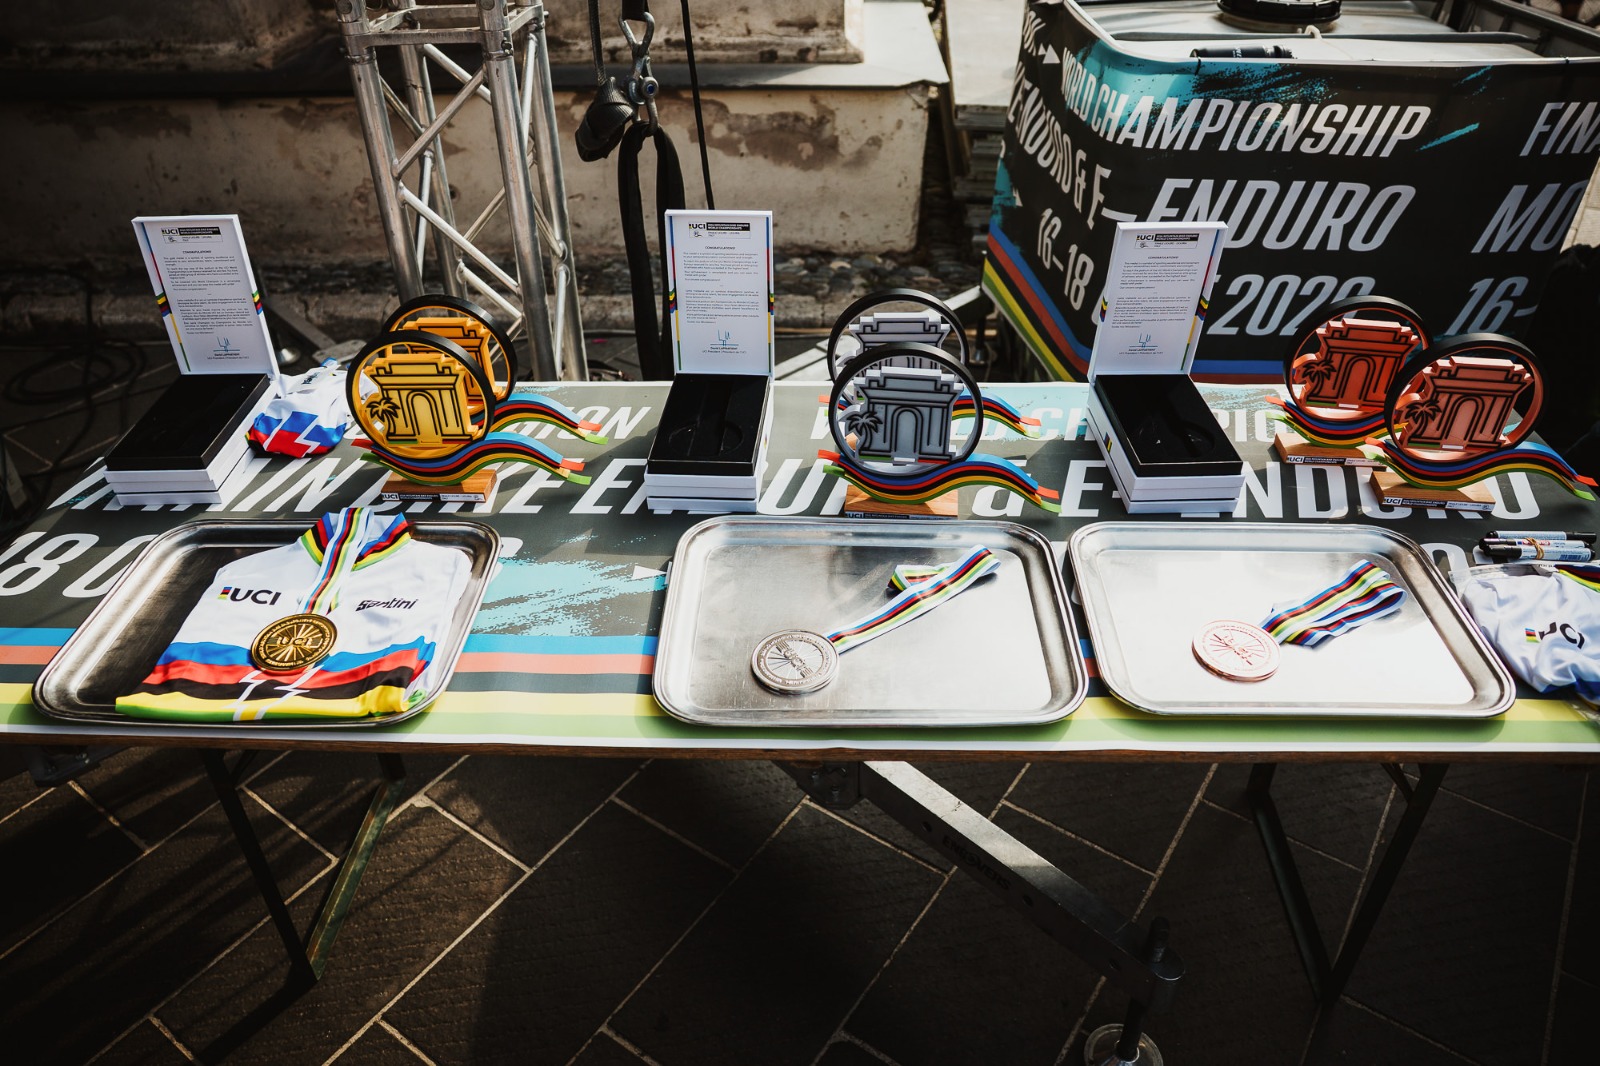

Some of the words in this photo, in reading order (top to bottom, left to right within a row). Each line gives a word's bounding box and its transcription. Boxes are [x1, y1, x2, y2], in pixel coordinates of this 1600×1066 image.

[1061, 46, 1097, 122] WORLD
[1091, 83, 1431, 157] CHAMPIONSHIP
[1037, 207, 1095, 311] 16-18
[230, 587, 281, 606] UCI
[356, 597, 419, 611] Santini
